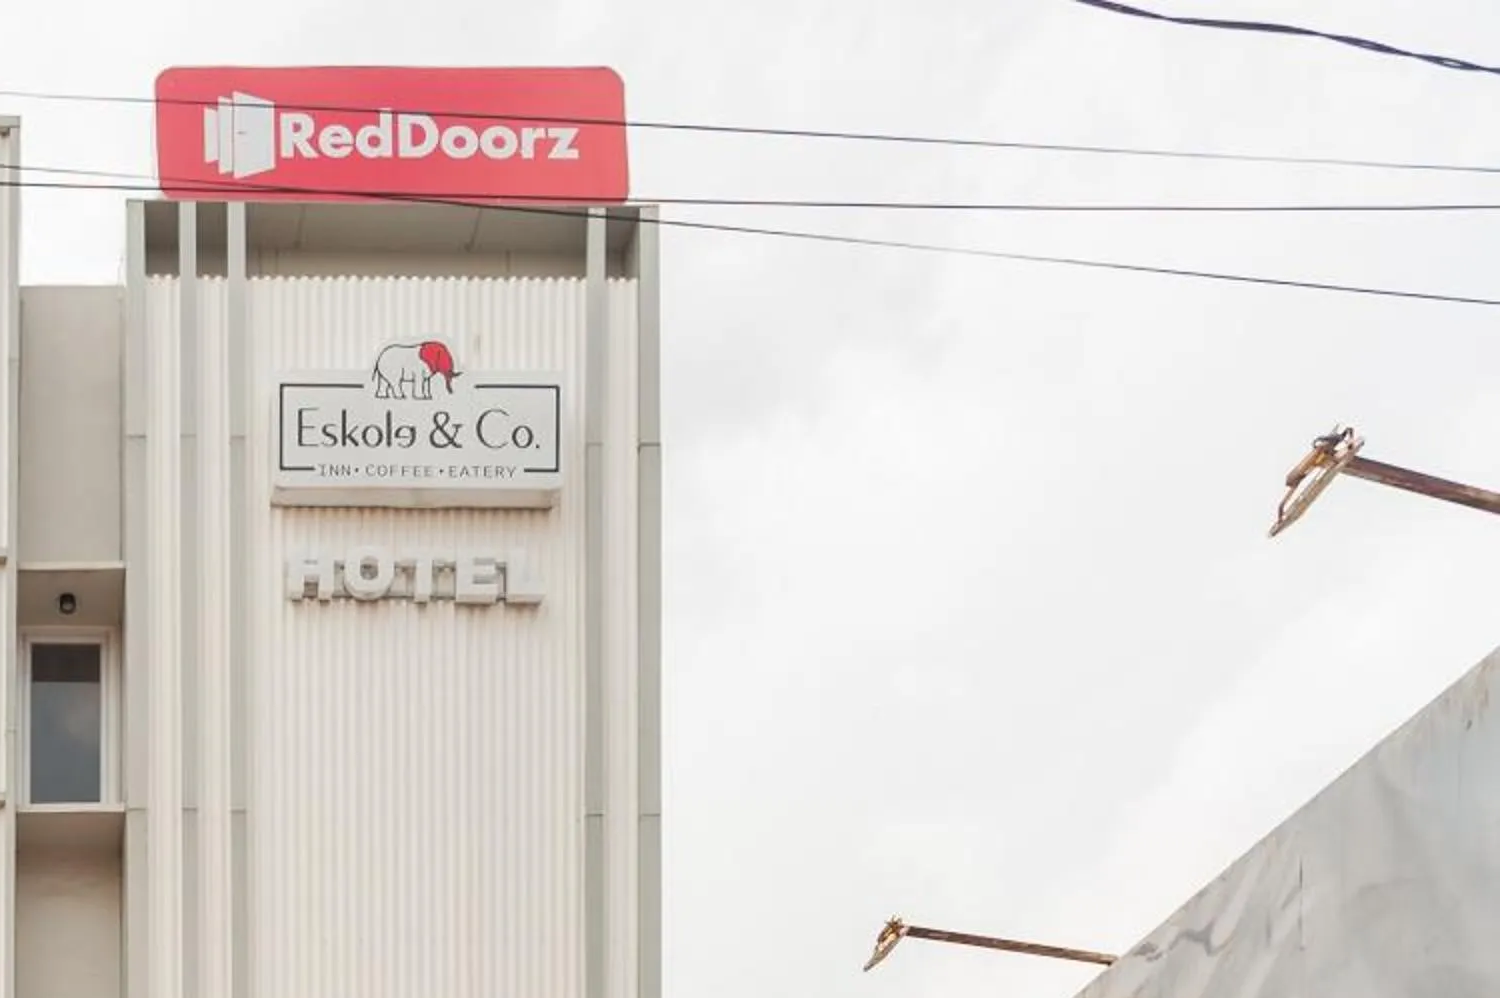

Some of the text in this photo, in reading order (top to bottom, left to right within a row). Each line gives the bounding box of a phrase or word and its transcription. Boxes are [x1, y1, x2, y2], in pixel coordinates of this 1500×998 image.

[279, 107, 580, 159] RedDoorz
[428, 410, 464, 449] &
[475, 407, 541, 450] Co.
[317, 463, 518, 479] INN COFFEE EATERY
[287, 546, 546, 604] HOTEL
